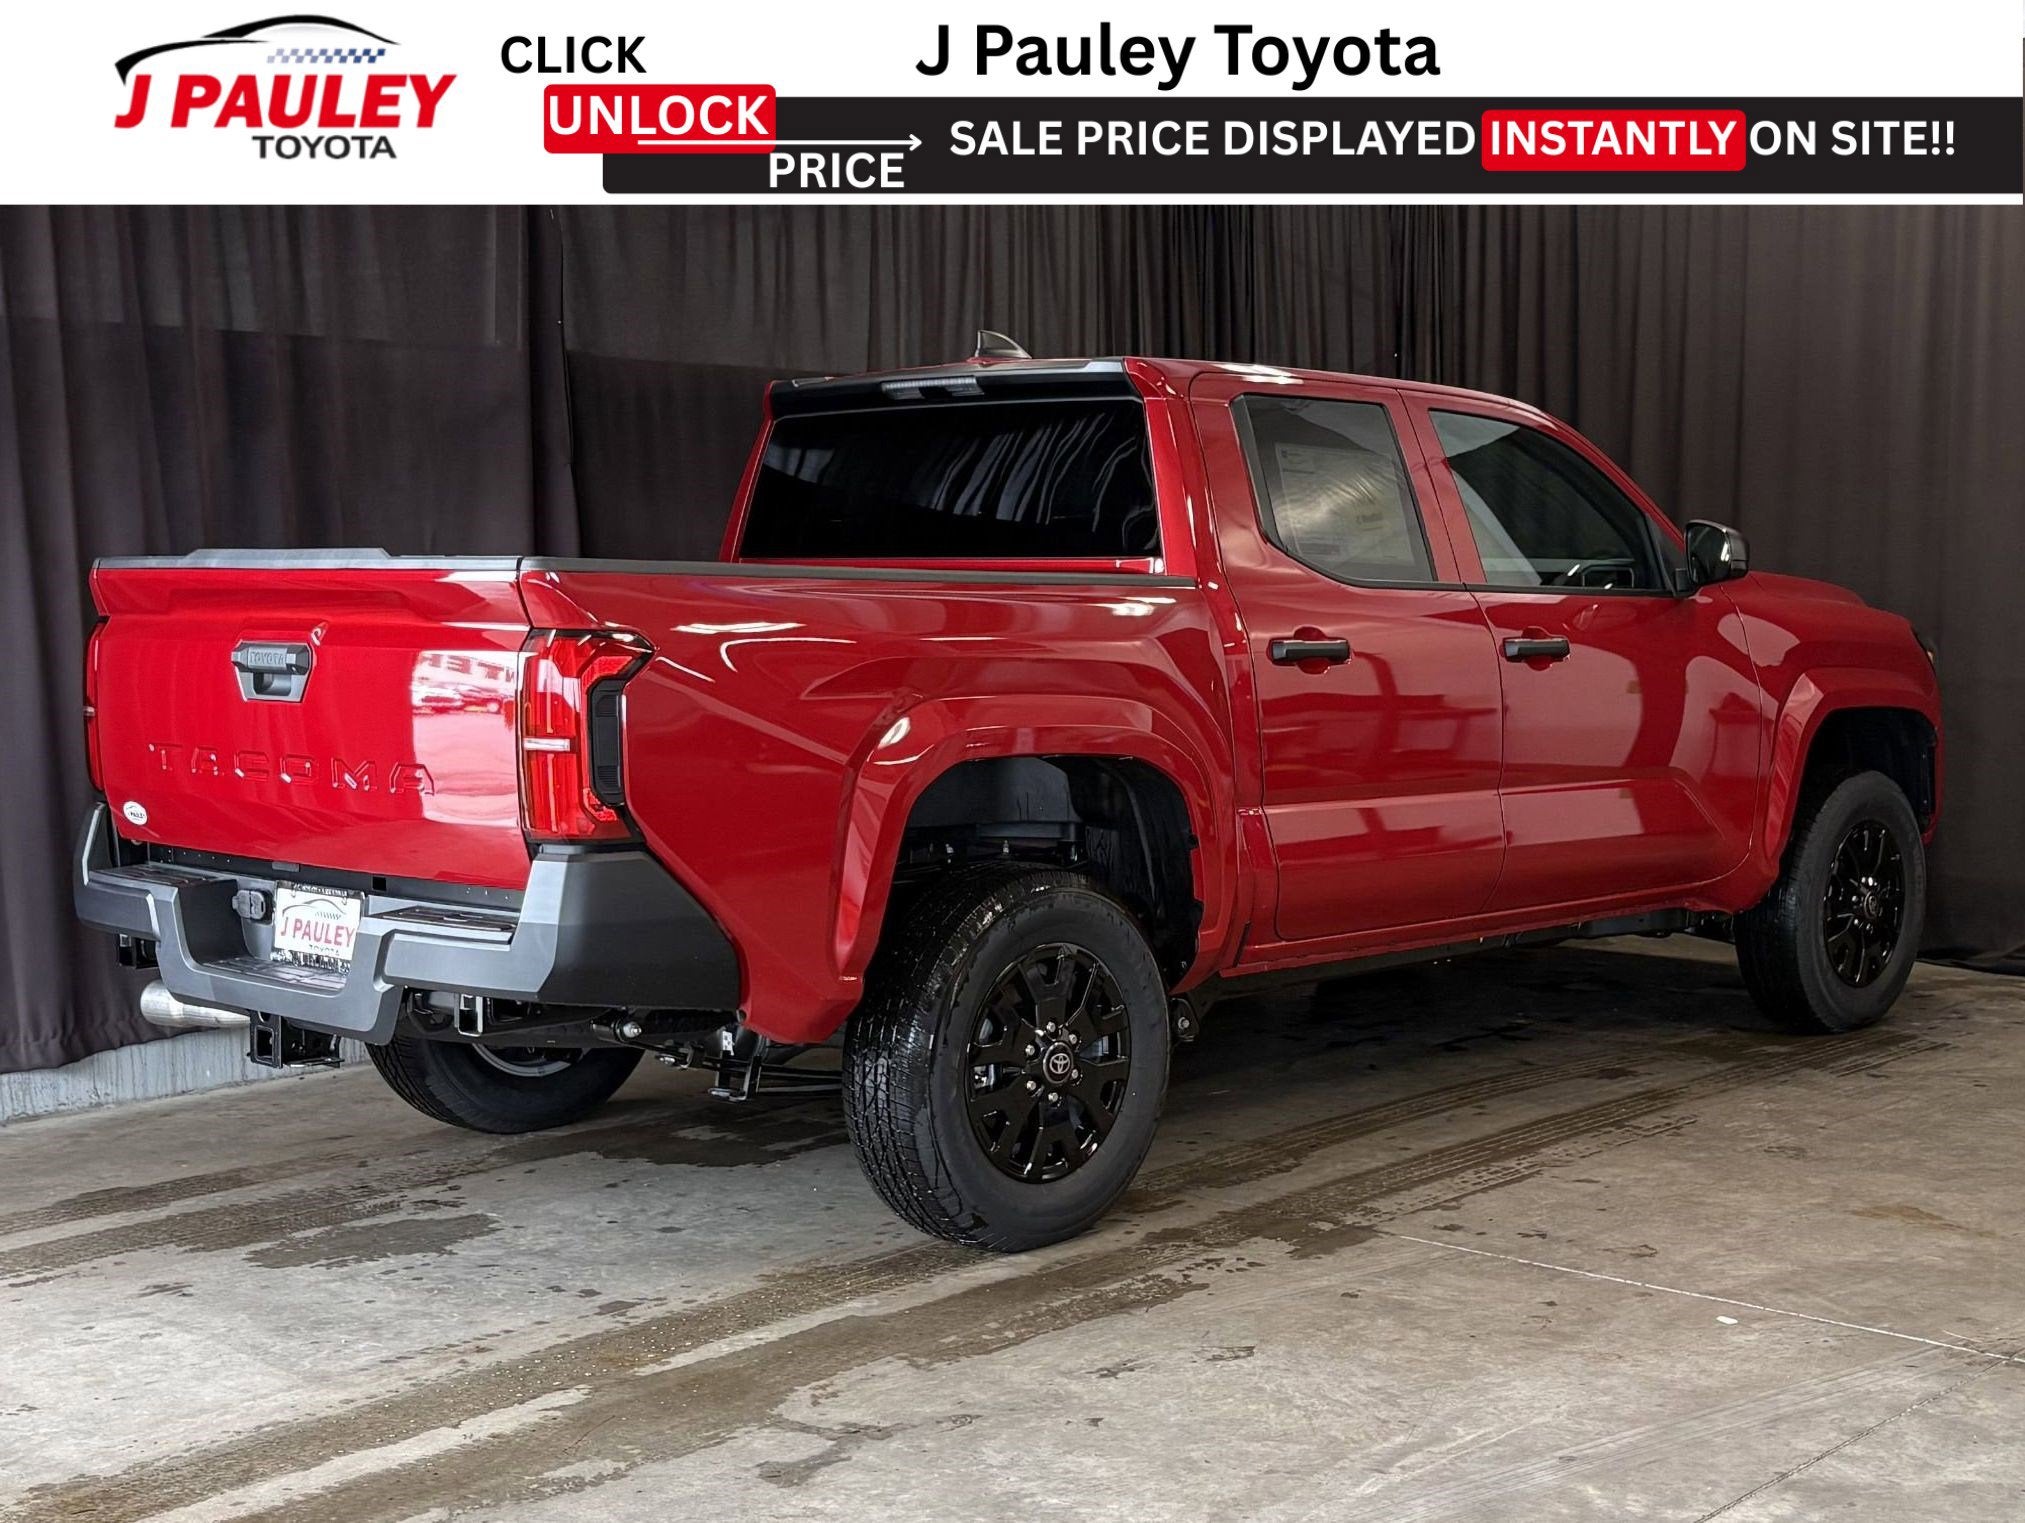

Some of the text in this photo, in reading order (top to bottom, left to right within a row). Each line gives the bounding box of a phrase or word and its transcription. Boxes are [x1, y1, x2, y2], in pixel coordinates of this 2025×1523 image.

[250, 651, 286, 666] TOYOTA
[148, 743, 435, 795] TACOMA
[280, 916, 355, 948] J PAULEY
